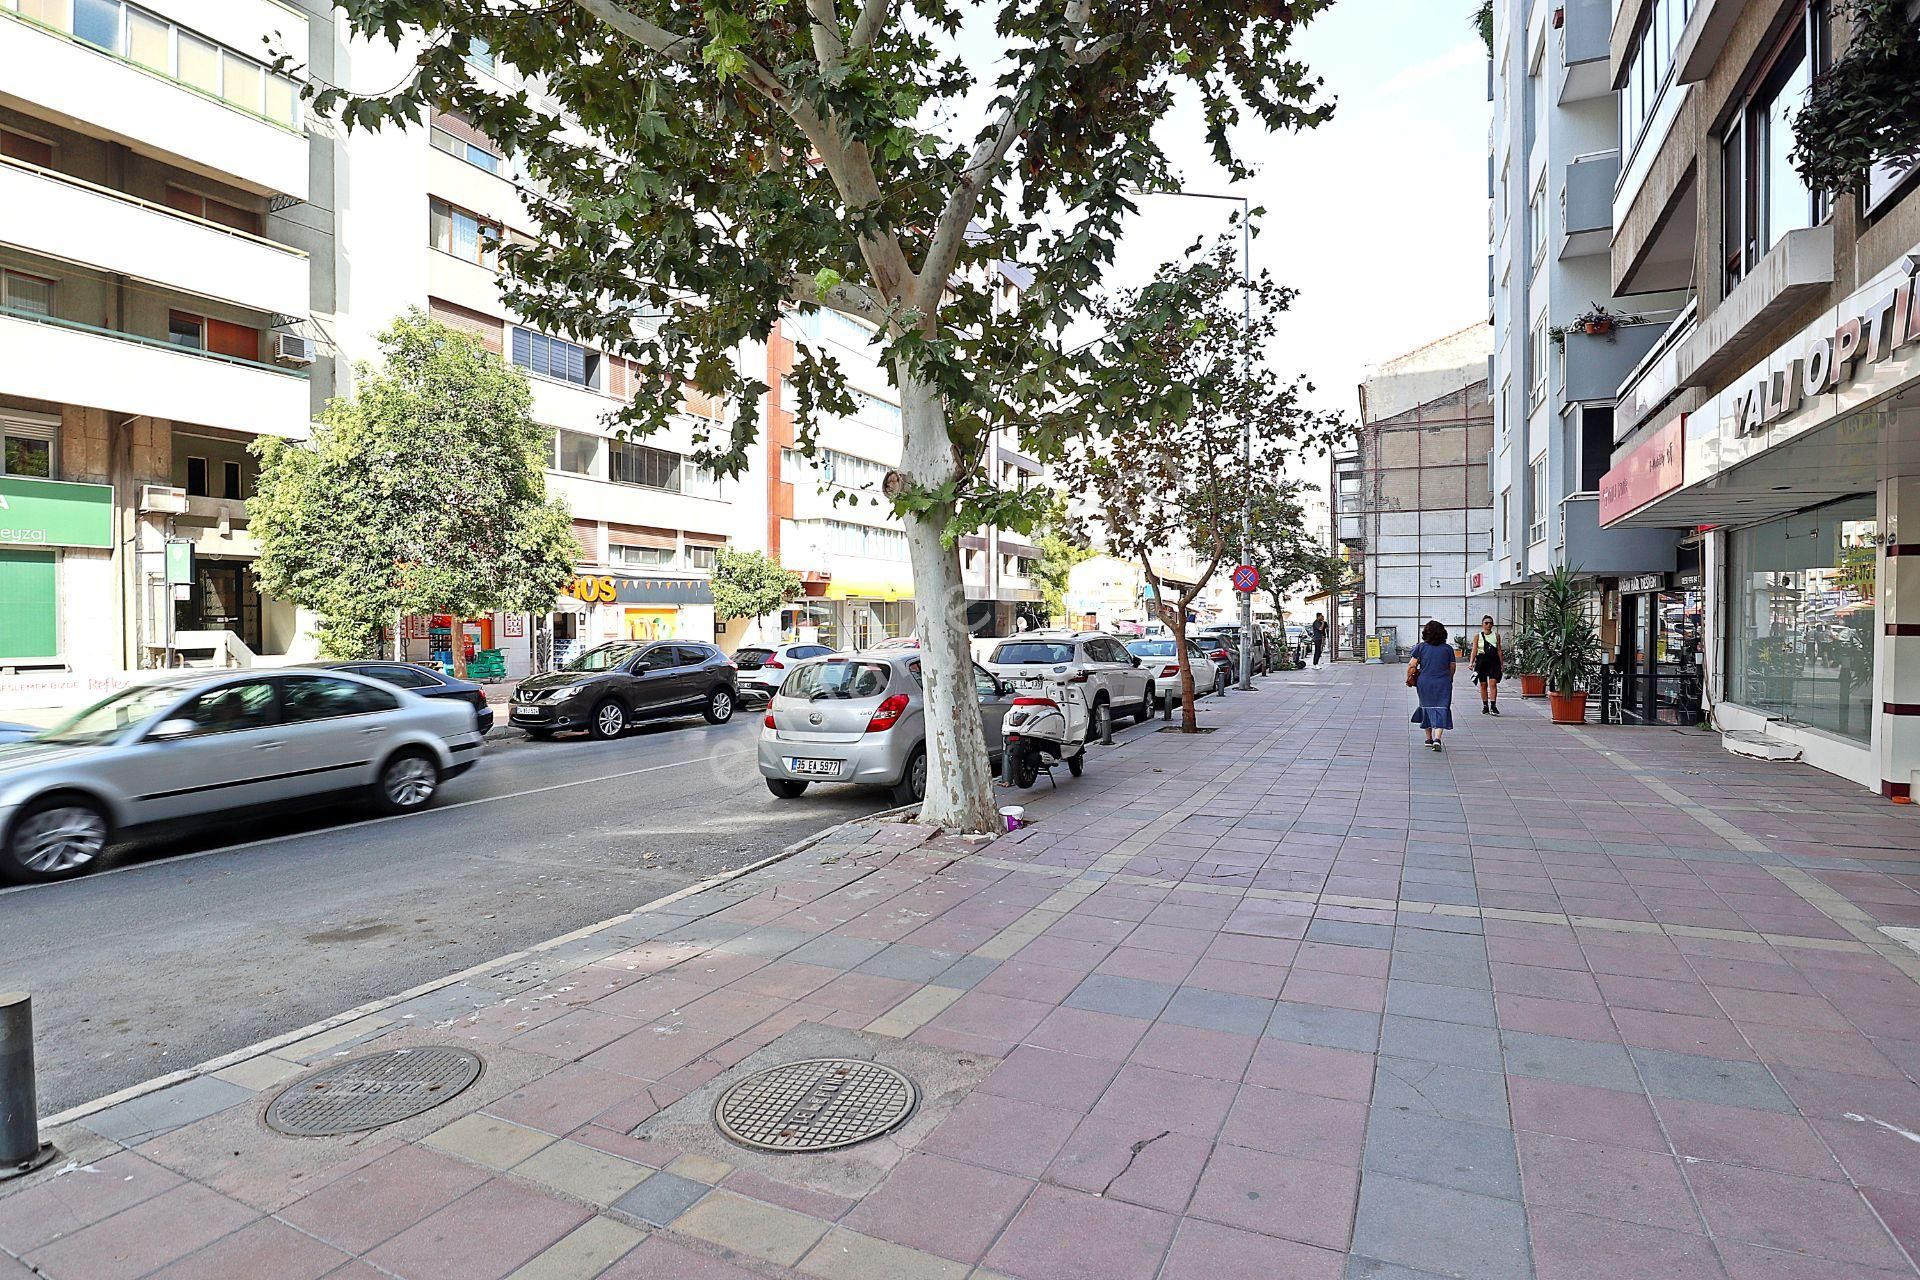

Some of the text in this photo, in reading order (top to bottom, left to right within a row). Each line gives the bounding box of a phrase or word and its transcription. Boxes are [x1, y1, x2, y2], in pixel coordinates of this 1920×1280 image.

[1733, 359, 1804, 439] YALI
[0, 528, 47, 543] eyzaj
[797, 760, 838, 771] 35 EA 5977
